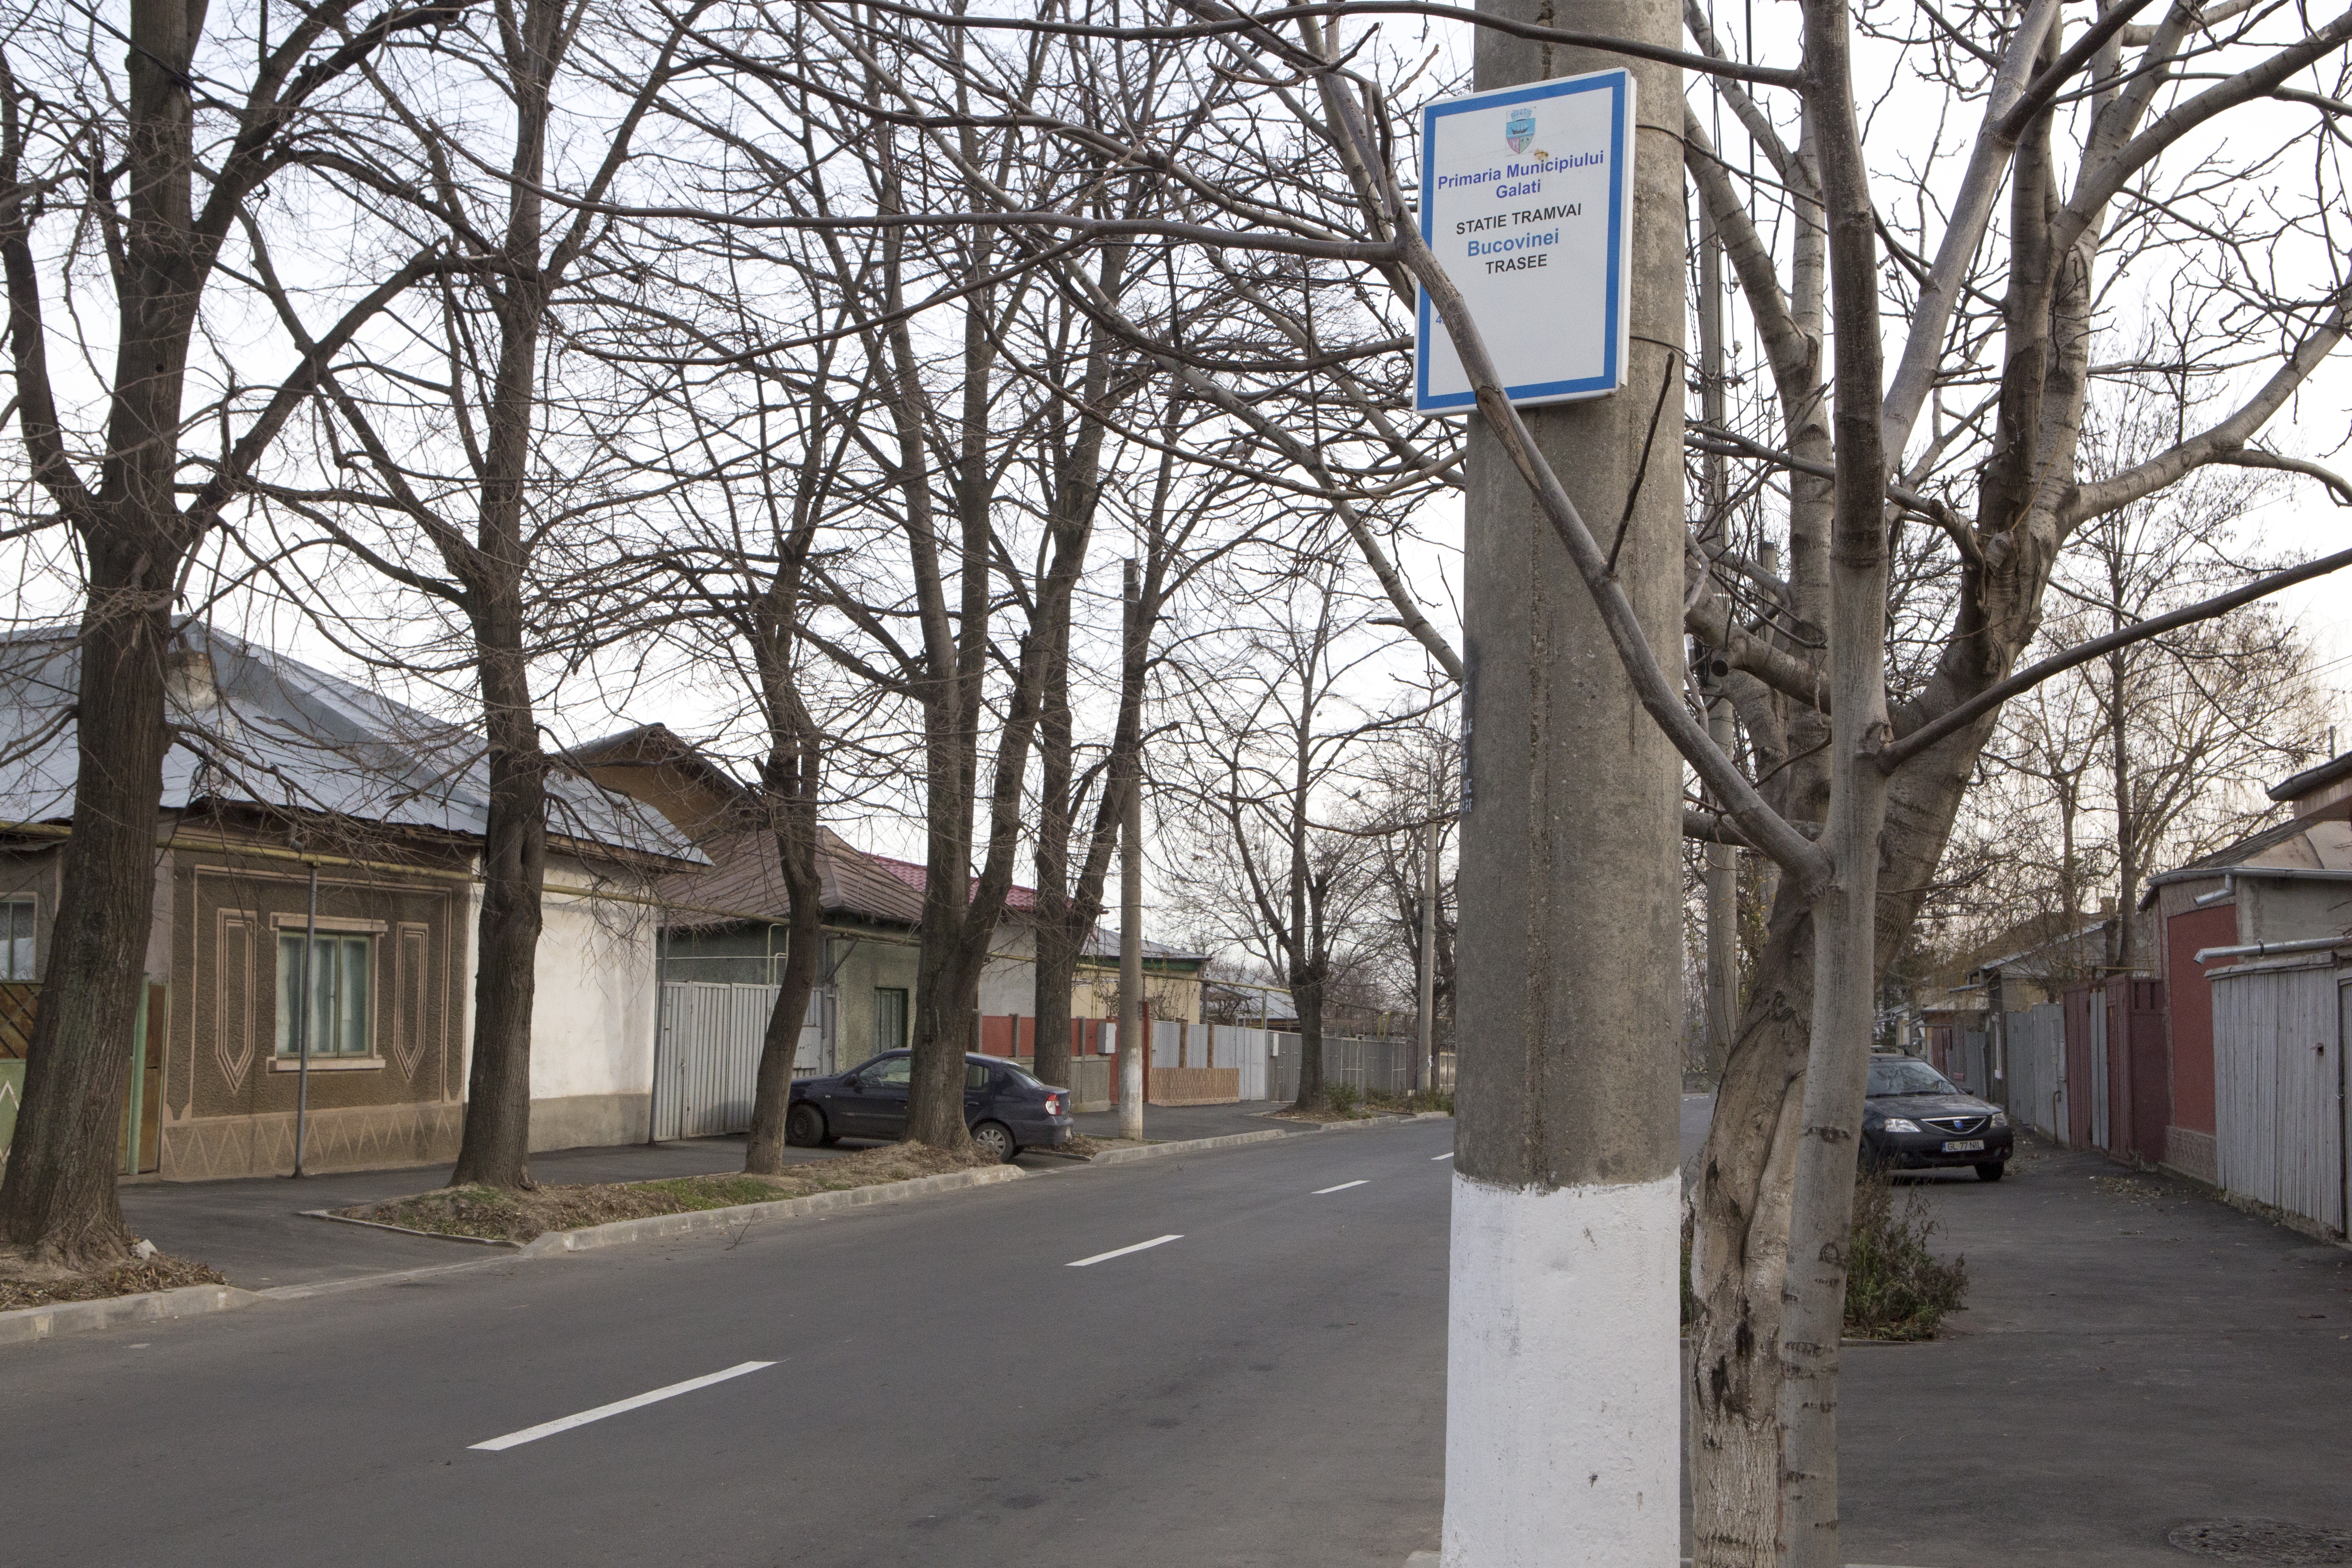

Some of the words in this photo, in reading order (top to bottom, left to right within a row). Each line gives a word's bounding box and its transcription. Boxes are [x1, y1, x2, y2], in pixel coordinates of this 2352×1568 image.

[1439, 168, 1501, 189] Primaria
[1507, 150, 1604, 178] Municipiului
[1496, 179, 1540, 198] Galati
[1456, 214, 1507, 235] STATIE
[1512, 203, 1581, 225] TRAMVAI
[1468, 228, 1559, 257] Bucovinei
[1485, 254, 1547, 274] TRASEE
[1970, 1141, 1981, 1149] NIL
